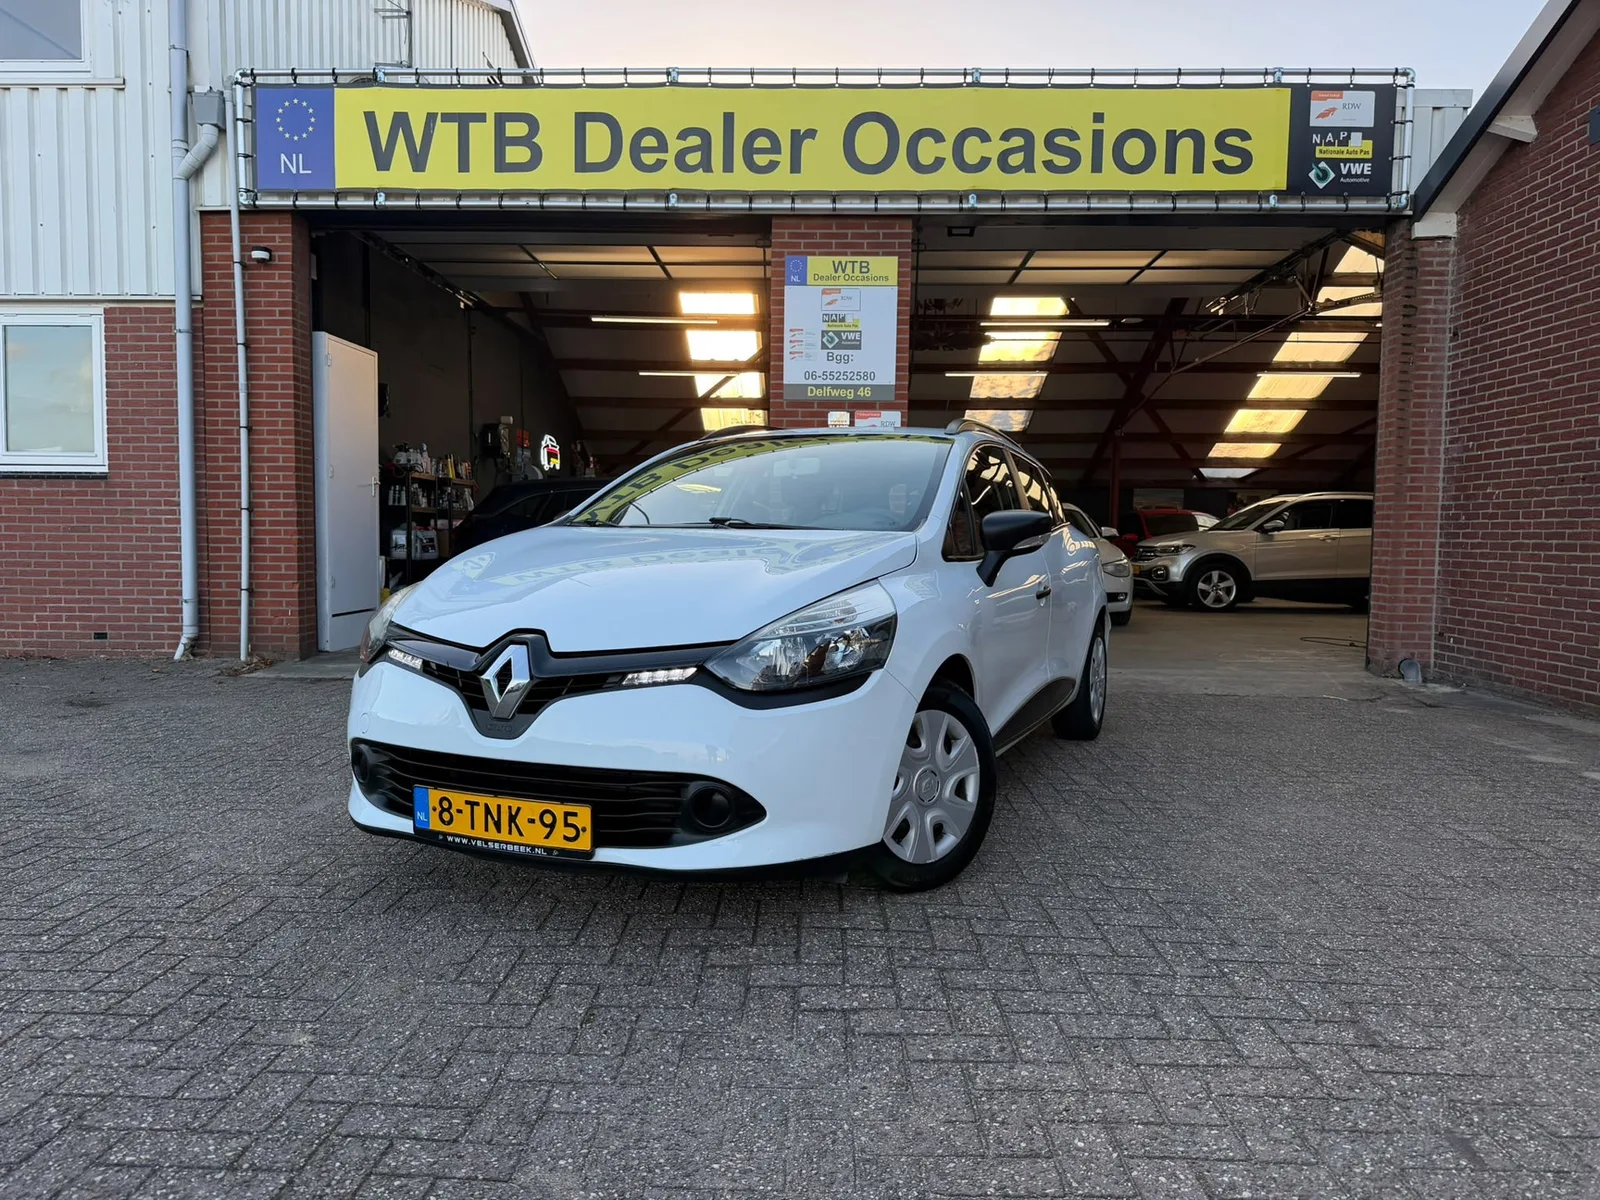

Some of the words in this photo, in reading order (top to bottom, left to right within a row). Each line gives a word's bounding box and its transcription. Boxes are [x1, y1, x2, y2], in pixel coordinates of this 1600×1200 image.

[1341, 102, 1361, 110] RDW
[363, 111, 543, 174] WTB
[573, 111, 818, 175] Dealer
[842, 111, 1254, 175] Occasions
[280, 153, 312, 175] NL
[1339, 162, 1372, 175] VWE
[832, 260, 870, 274] WTB
[813, 273, 841, 282] Dealer
[843, 273, 889, 282] Occasions
[841, 332, 861, 340] VWE
[826, 351, 854, 364] Bgg:
[803, 370, 876, 381] 06-55252580
[807, 386, 855, 399] Delfweg
[857, 386, 871, 397] 46
[416, 811, 428, 821] NL
[438, 796, 581, 843] 8-TNK-95
[446, 835, 548, 856] WWW.VELSERBEEK.NL
